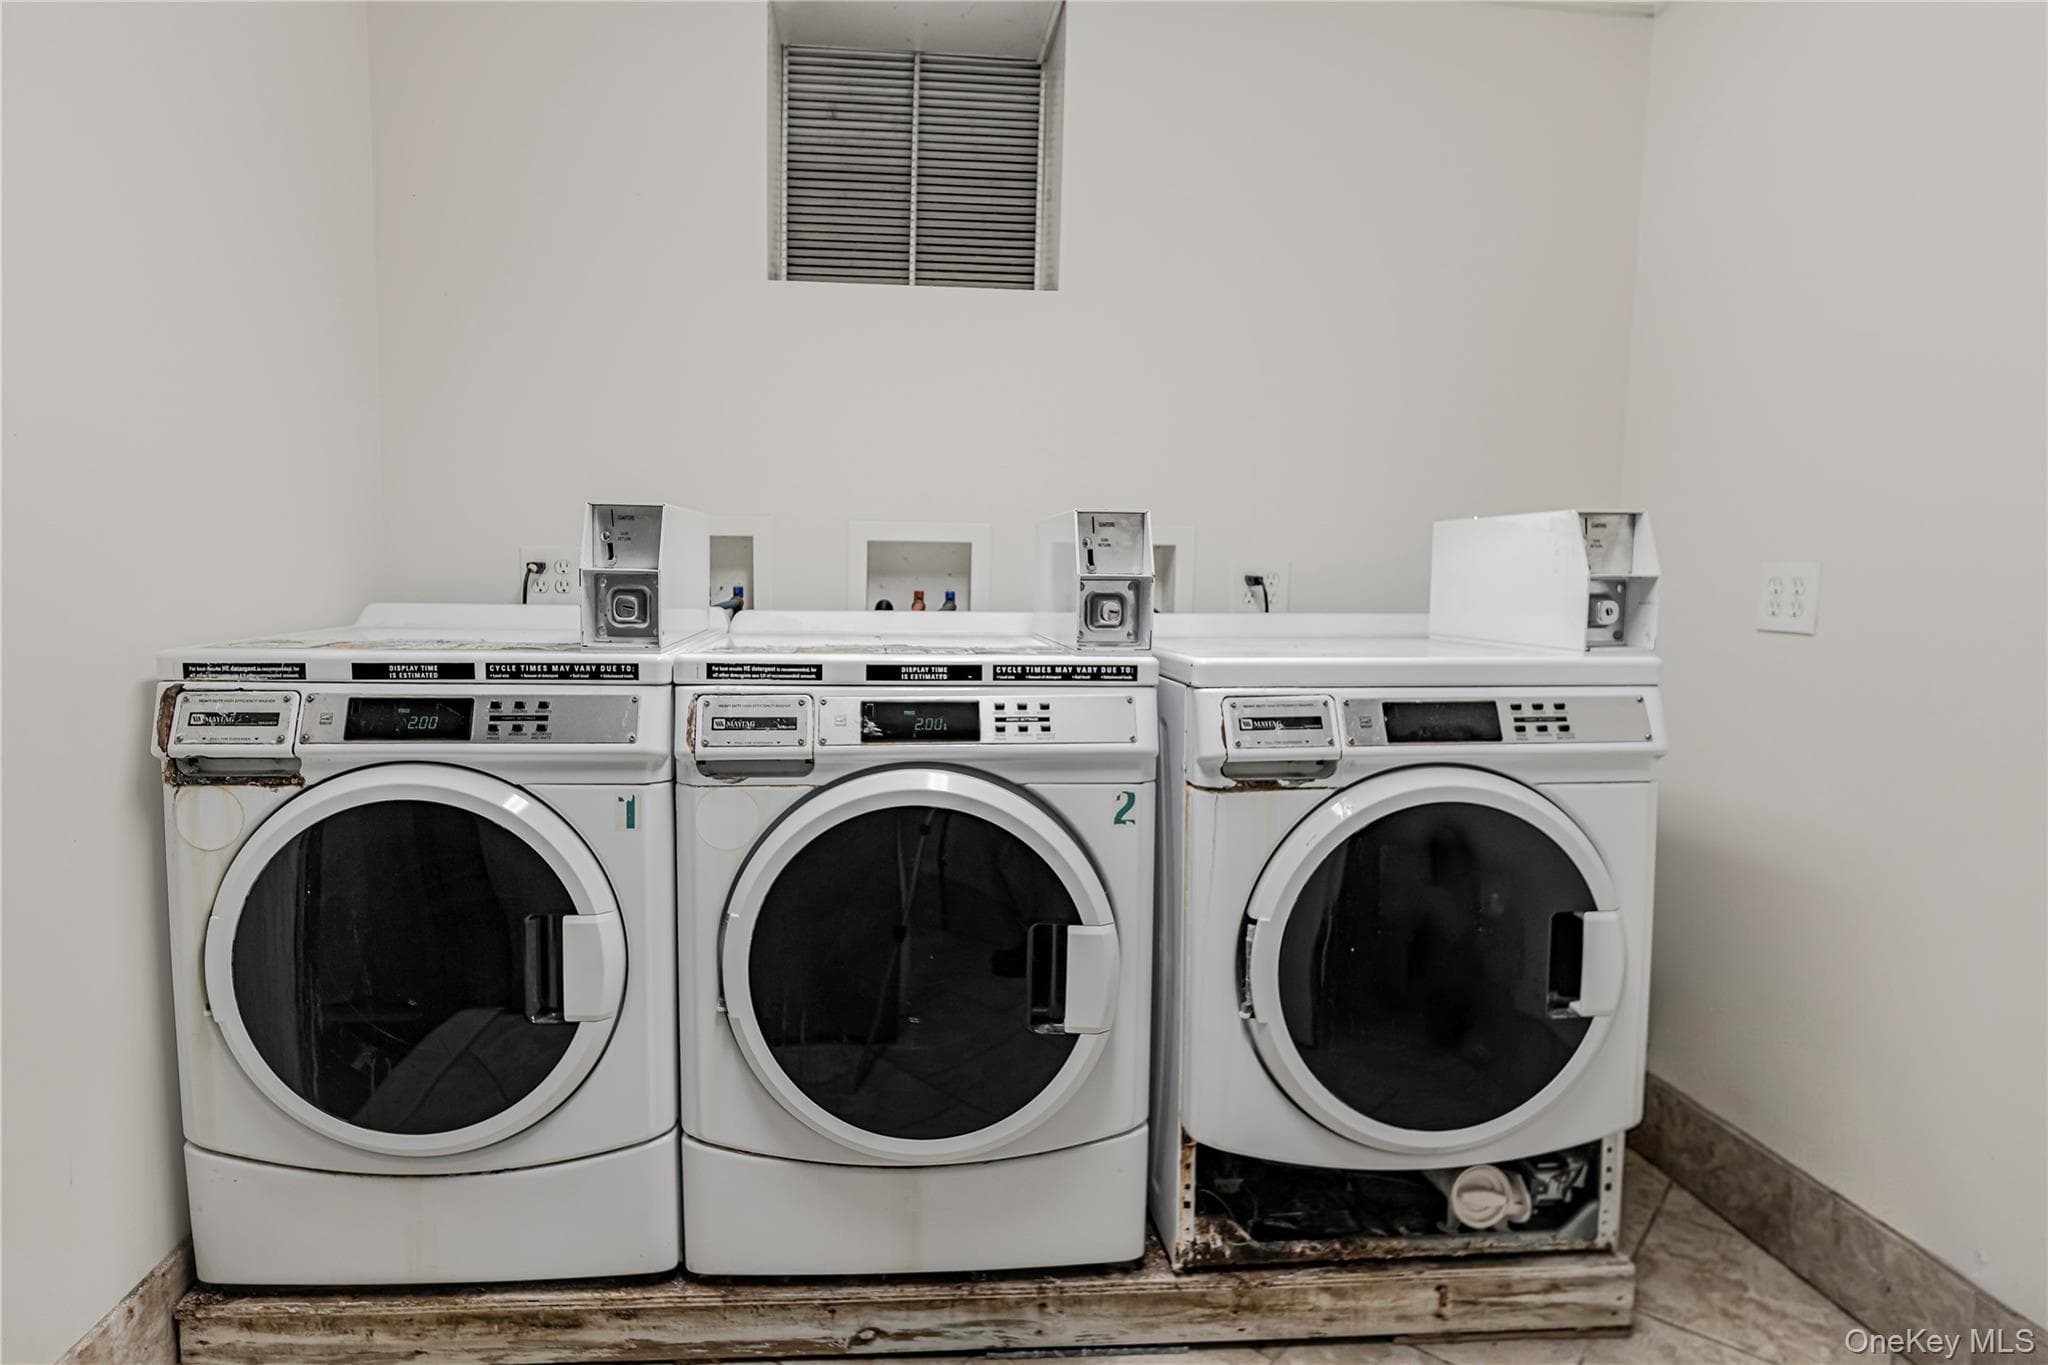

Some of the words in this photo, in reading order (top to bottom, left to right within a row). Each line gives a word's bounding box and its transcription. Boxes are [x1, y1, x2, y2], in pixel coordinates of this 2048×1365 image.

[489, 664, 517, 672] CYCLE
[520, 664, 548, 672] TIMES
[551, 664, 570, 672] MAY
[751, 665, 776, 673] detergent
[1055, 666, 1073, 674] MAY
[1076, 666, 1098, 674] VARY
[1101, 666, 1117, 674] DUE
[407, 716, 439, 730] 2.00
[726, 719, 756, 728] MAYTAG
[914, 717, 944, 731] 2.00
[617, 794, 635, 829] 1
[1113, 791, 1136, 825] 2
